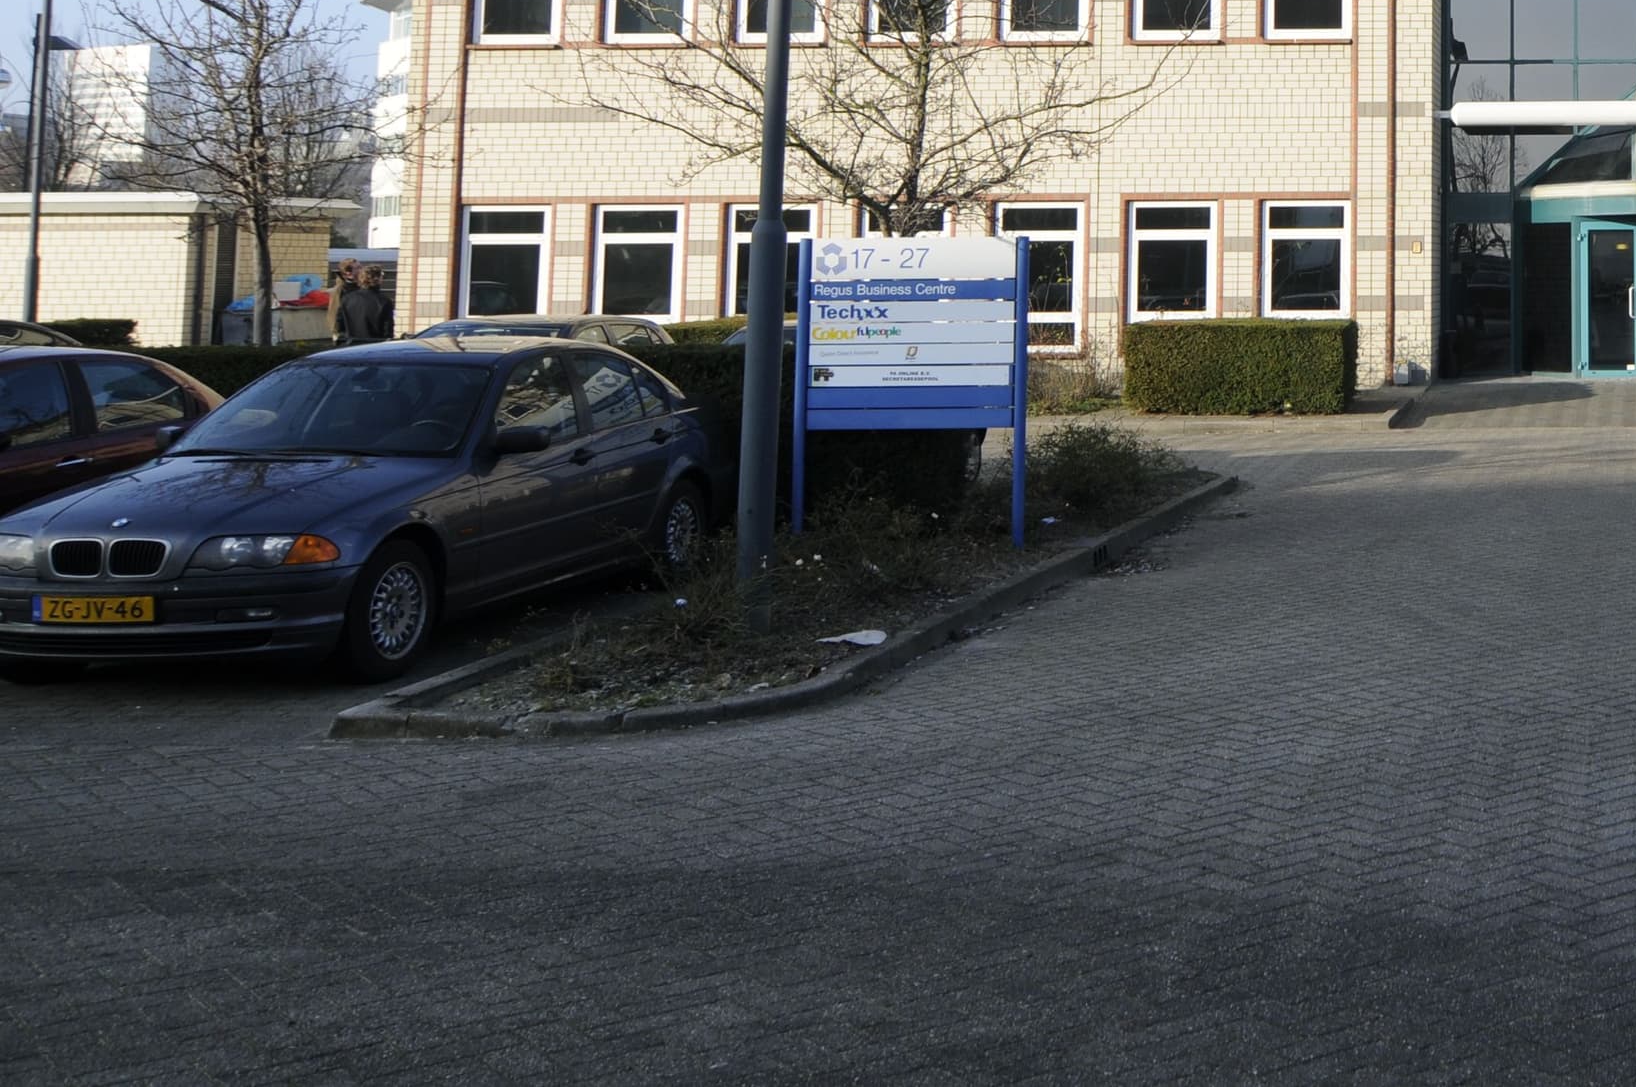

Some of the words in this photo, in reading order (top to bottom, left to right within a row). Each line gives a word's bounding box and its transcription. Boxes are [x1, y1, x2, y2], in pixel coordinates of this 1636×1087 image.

[851, 248, 875, 269] 17
[900, 247, 930, 269] 27
[814, 284, 853, 298] Regus
[857, 284, 911, 296] Business
[915, 283, 956, 295] Centre
[48, 600, 145, 619] ZG-JV-46
